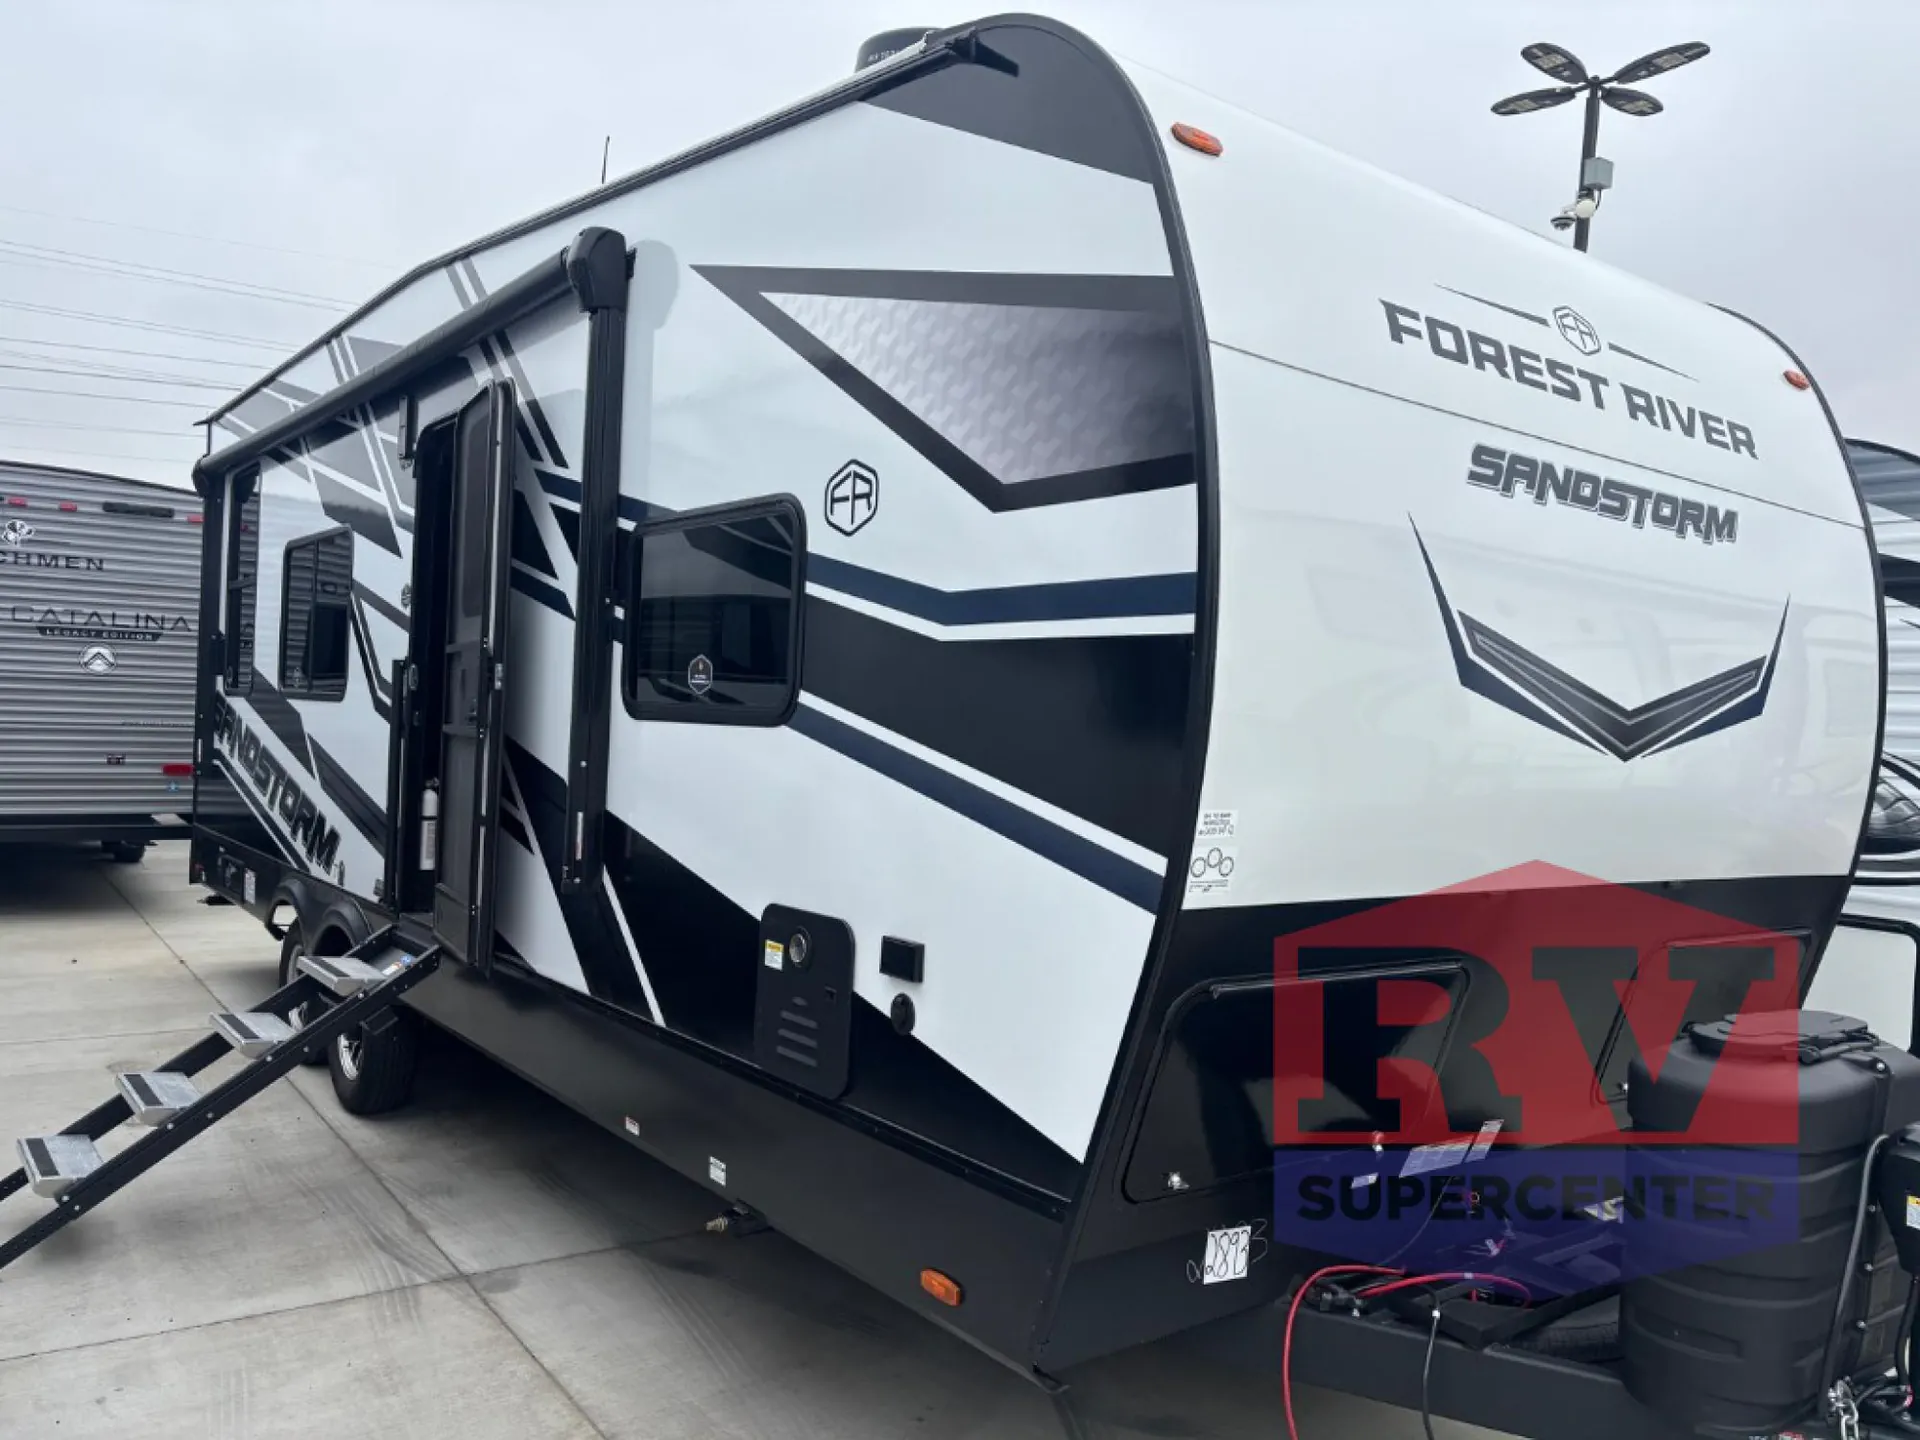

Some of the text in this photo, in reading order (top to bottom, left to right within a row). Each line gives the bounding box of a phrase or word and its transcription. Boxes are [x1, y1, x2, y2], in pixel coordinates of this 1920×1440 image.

[1379, 299, 1760, 460] FOREST RIVER
[1467, 443, 1739, 544] SANDSTORM
[11, 605, 192, 632] CATALINA
[46, 627, 154, 641] LEGACY EDITION
